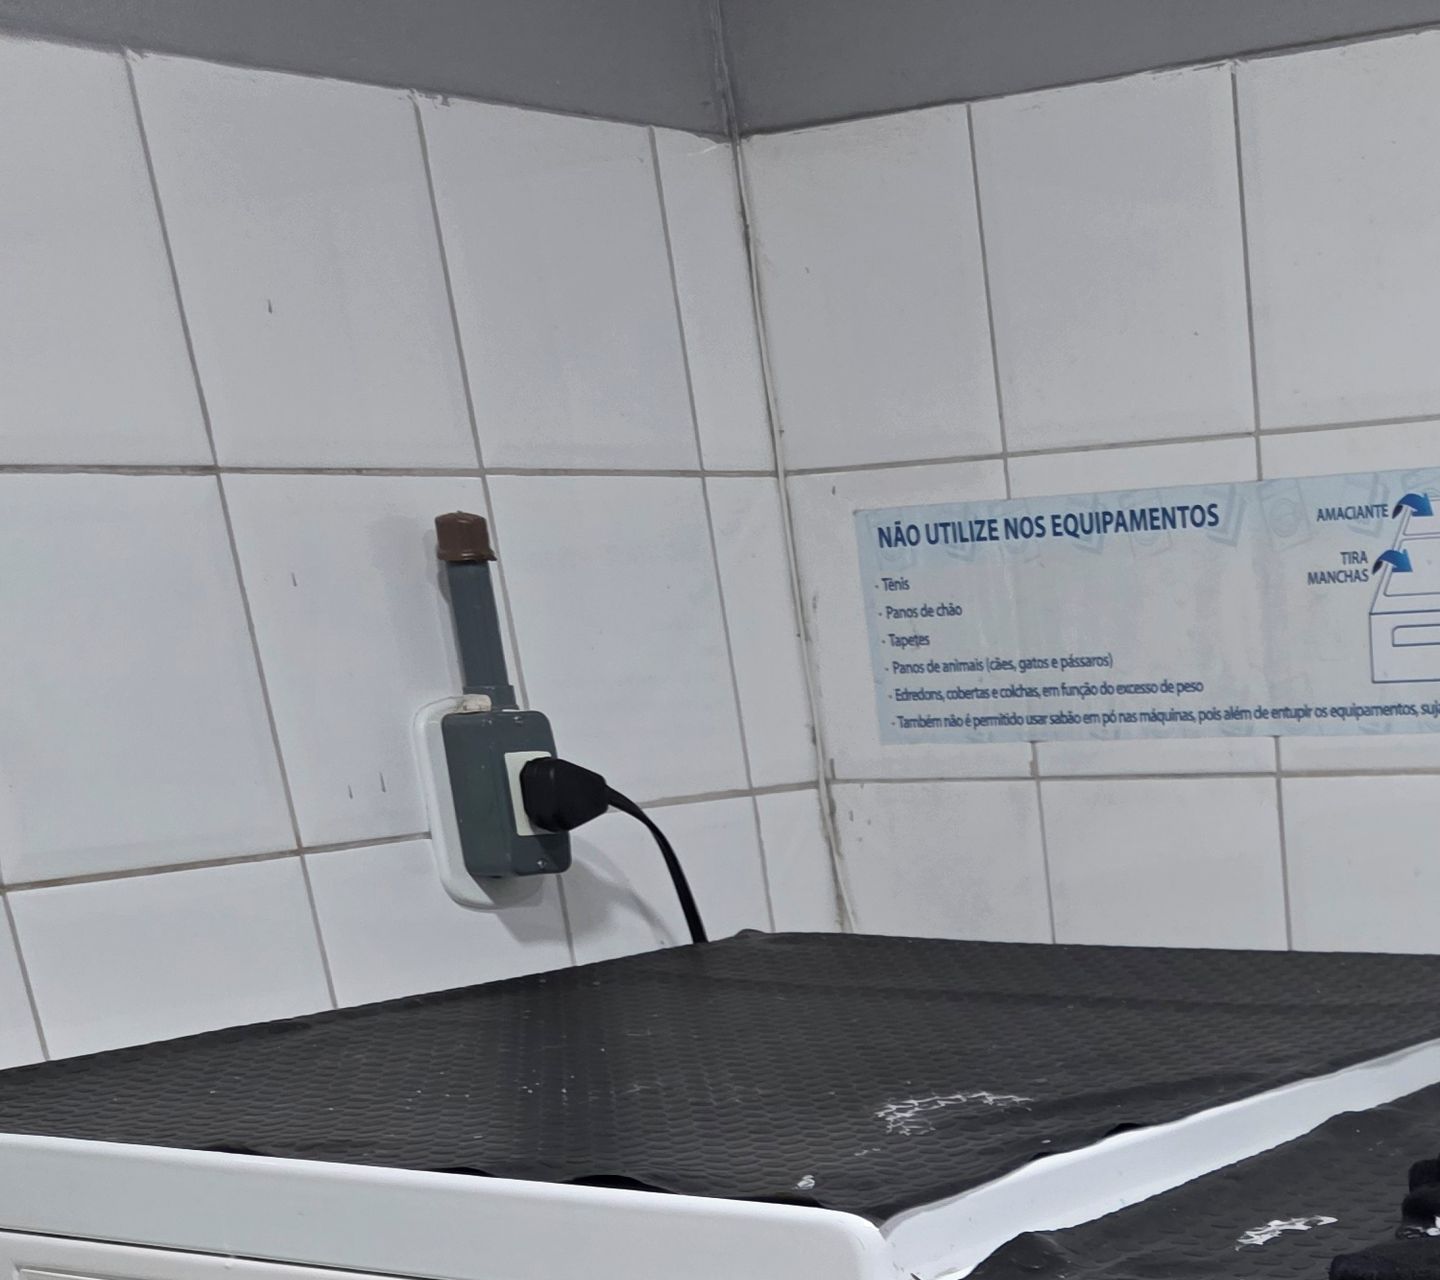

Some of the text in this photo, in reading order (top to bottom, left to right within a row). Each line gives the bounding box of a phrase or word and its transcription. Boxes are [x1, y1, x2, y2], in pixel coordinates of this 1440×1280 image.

[1315, 502, 1389, 522] AMACIANTE
[877, 502, 1219, 548] NÃO UTILIZE NOS EQUIPAMENTOS
[1339, 550, 1368, 565] TIRA
[880, 576, 910, 591] Tênis
[1307, 567, 1370, 584] MANCHAS
[884, 601, 963, 619] Panos de chão
[887, 632, 930, 650] Tapetes
[891, 652, 1113, 674] Panos de animais (cães, gatos e pássaros)
[894, 678, 1204, 702] Edredons, cobertas e colchas, em função do excesso de peso
